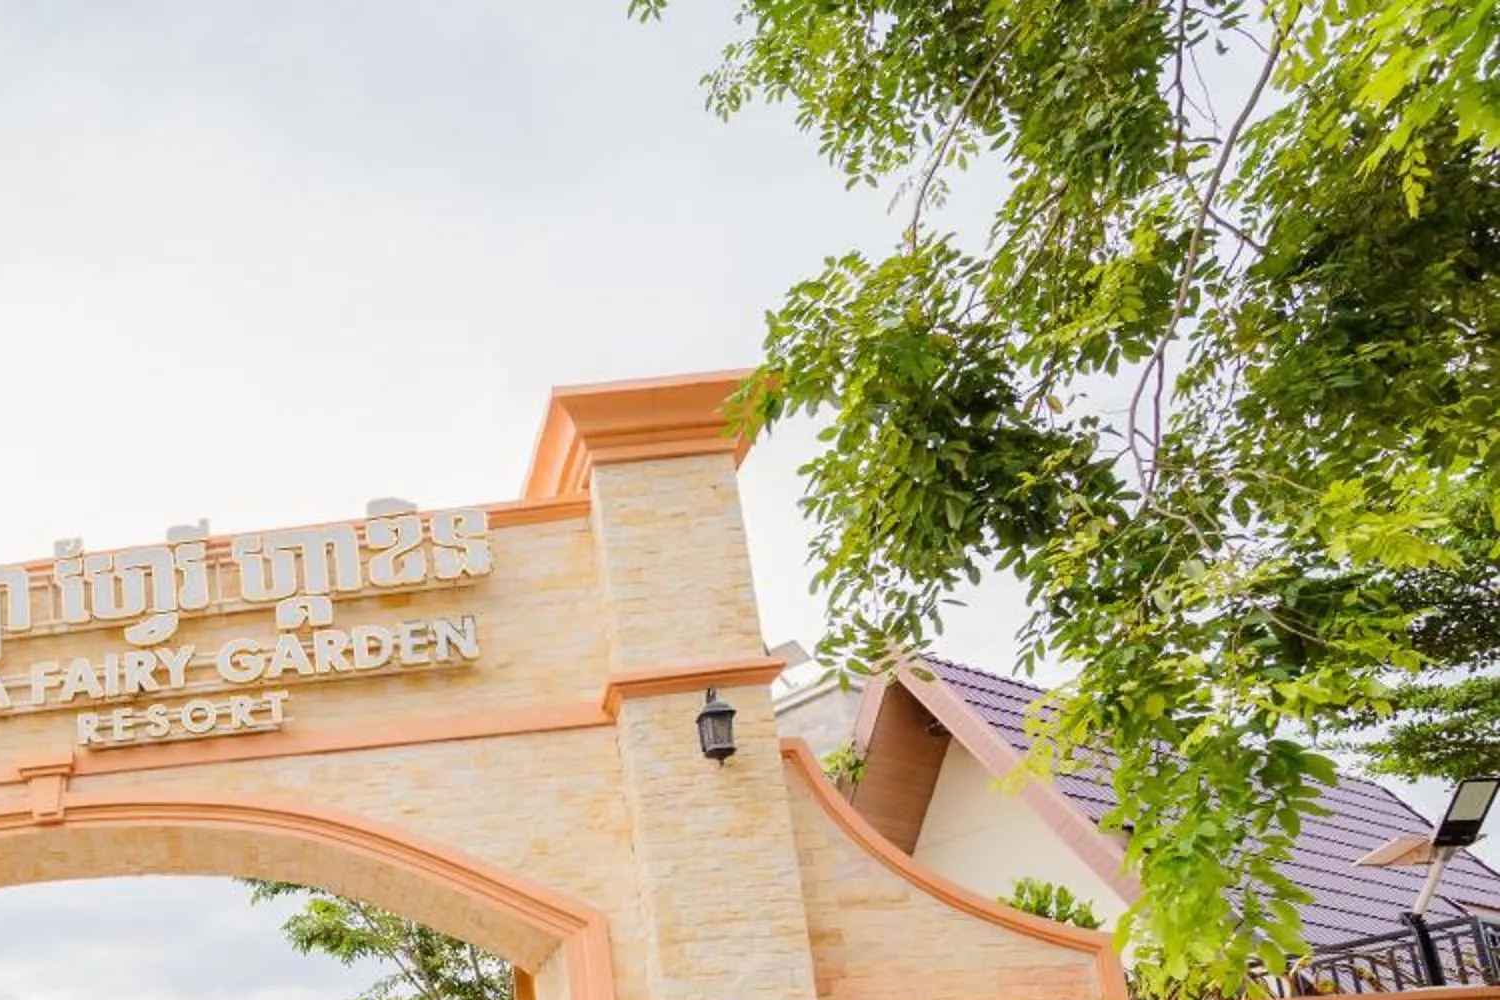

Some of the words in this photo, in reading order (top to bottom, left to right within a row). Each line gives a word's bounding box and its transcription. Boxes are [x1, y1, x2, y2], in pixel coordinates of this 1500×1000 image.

[31, 643, 197, 703] FAIRY
[216, 615, 481, 686] GARDEN
[77, 690, 289, 746] RESORT
